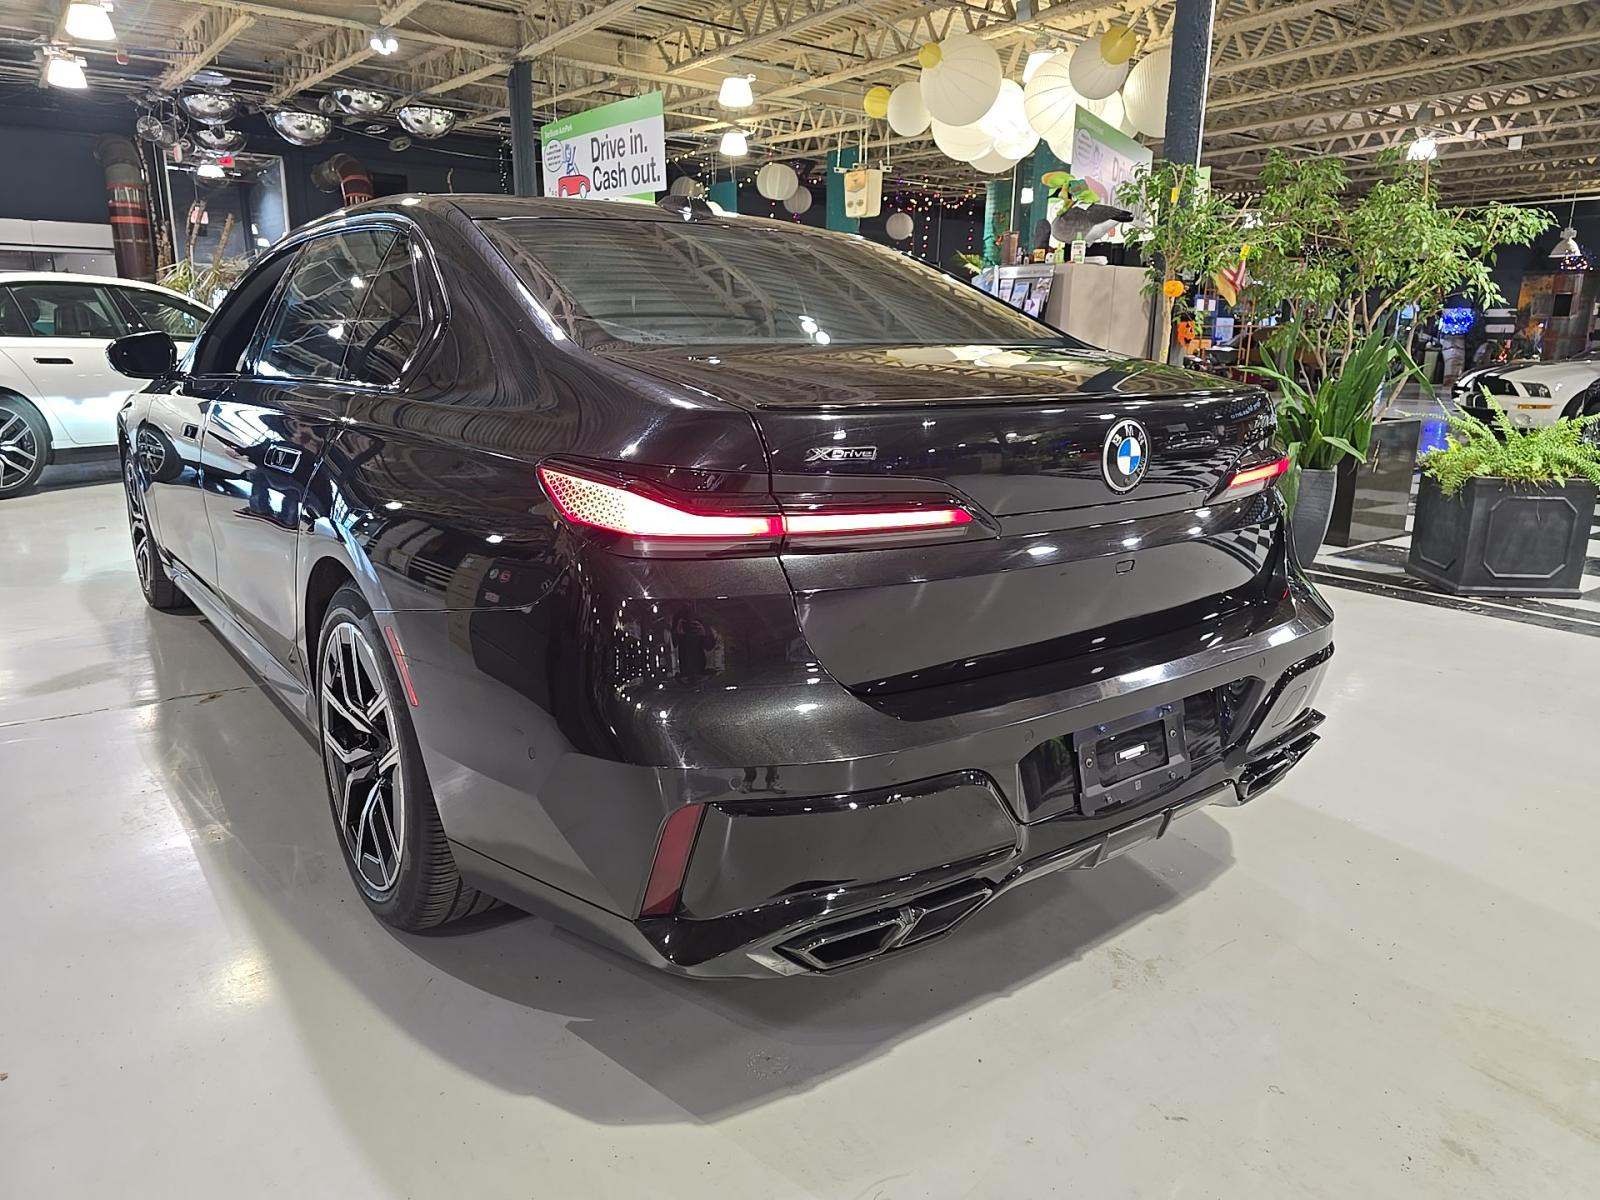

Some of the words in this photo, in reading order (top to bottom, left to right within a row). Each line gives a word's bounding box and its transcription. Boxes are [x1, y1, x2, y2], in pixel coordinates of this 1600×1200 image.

[590, 133, 626, 163] Drive
[629, 127, 648, 156] in.
[592, 162, 628, 191] Cash
[631, 156, 661, 186] out.
[1111, 423, 1146, 447] BMW
